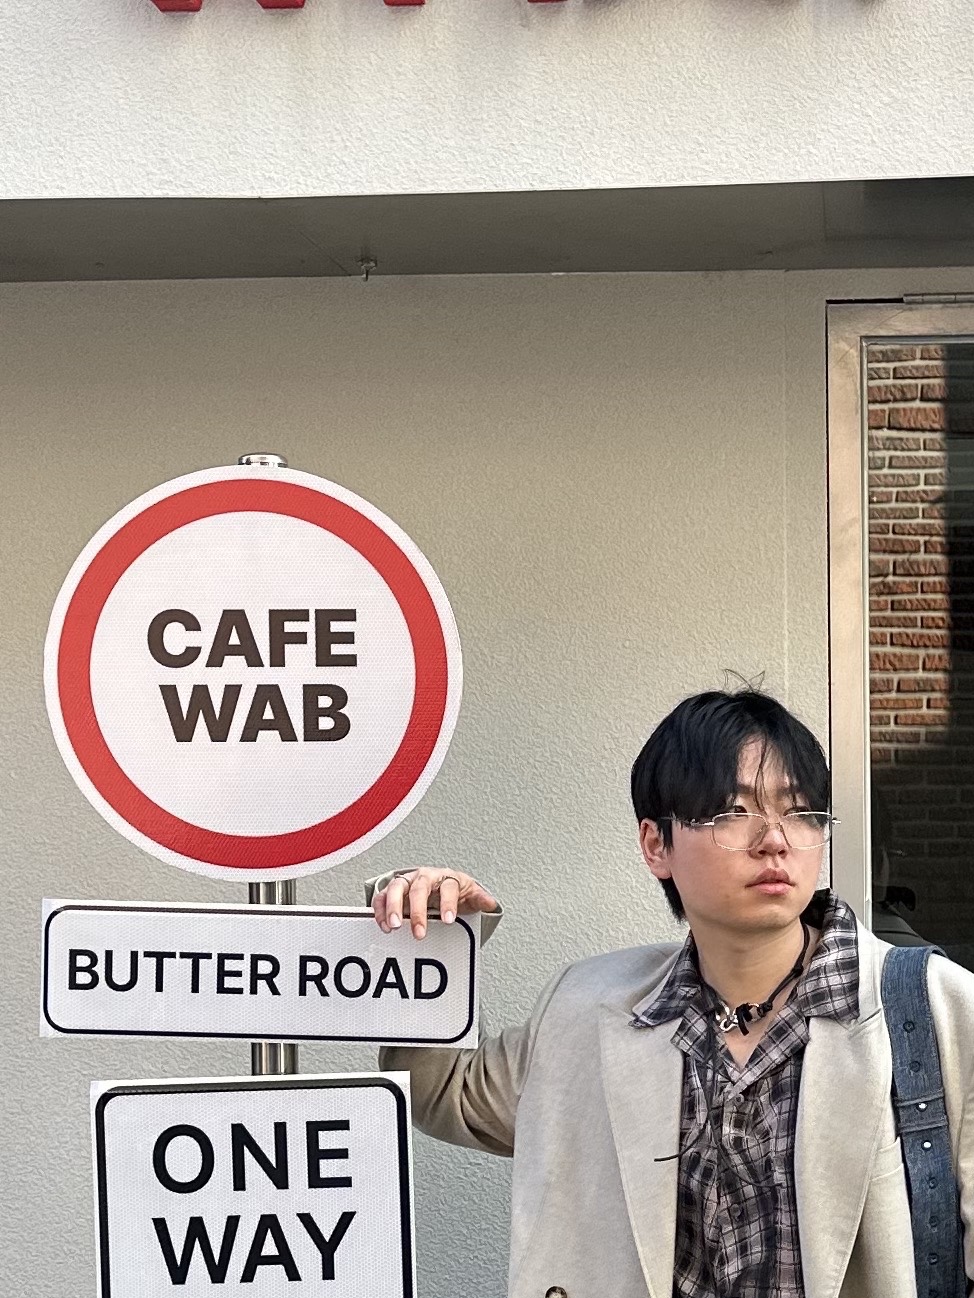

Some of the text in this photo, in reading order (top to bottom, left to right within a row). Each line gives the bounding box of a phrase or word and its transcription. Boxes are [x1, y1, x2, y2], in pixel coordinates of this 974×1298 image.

[147, 608, 358, 669] CAFE
[158, 684, 351, 742] WAB
[67, 948, 449, 1000] BUTTER ROAD
[152, 1119, 353, 1195] ONE
[151, 1211, 357, 1286] WAY
